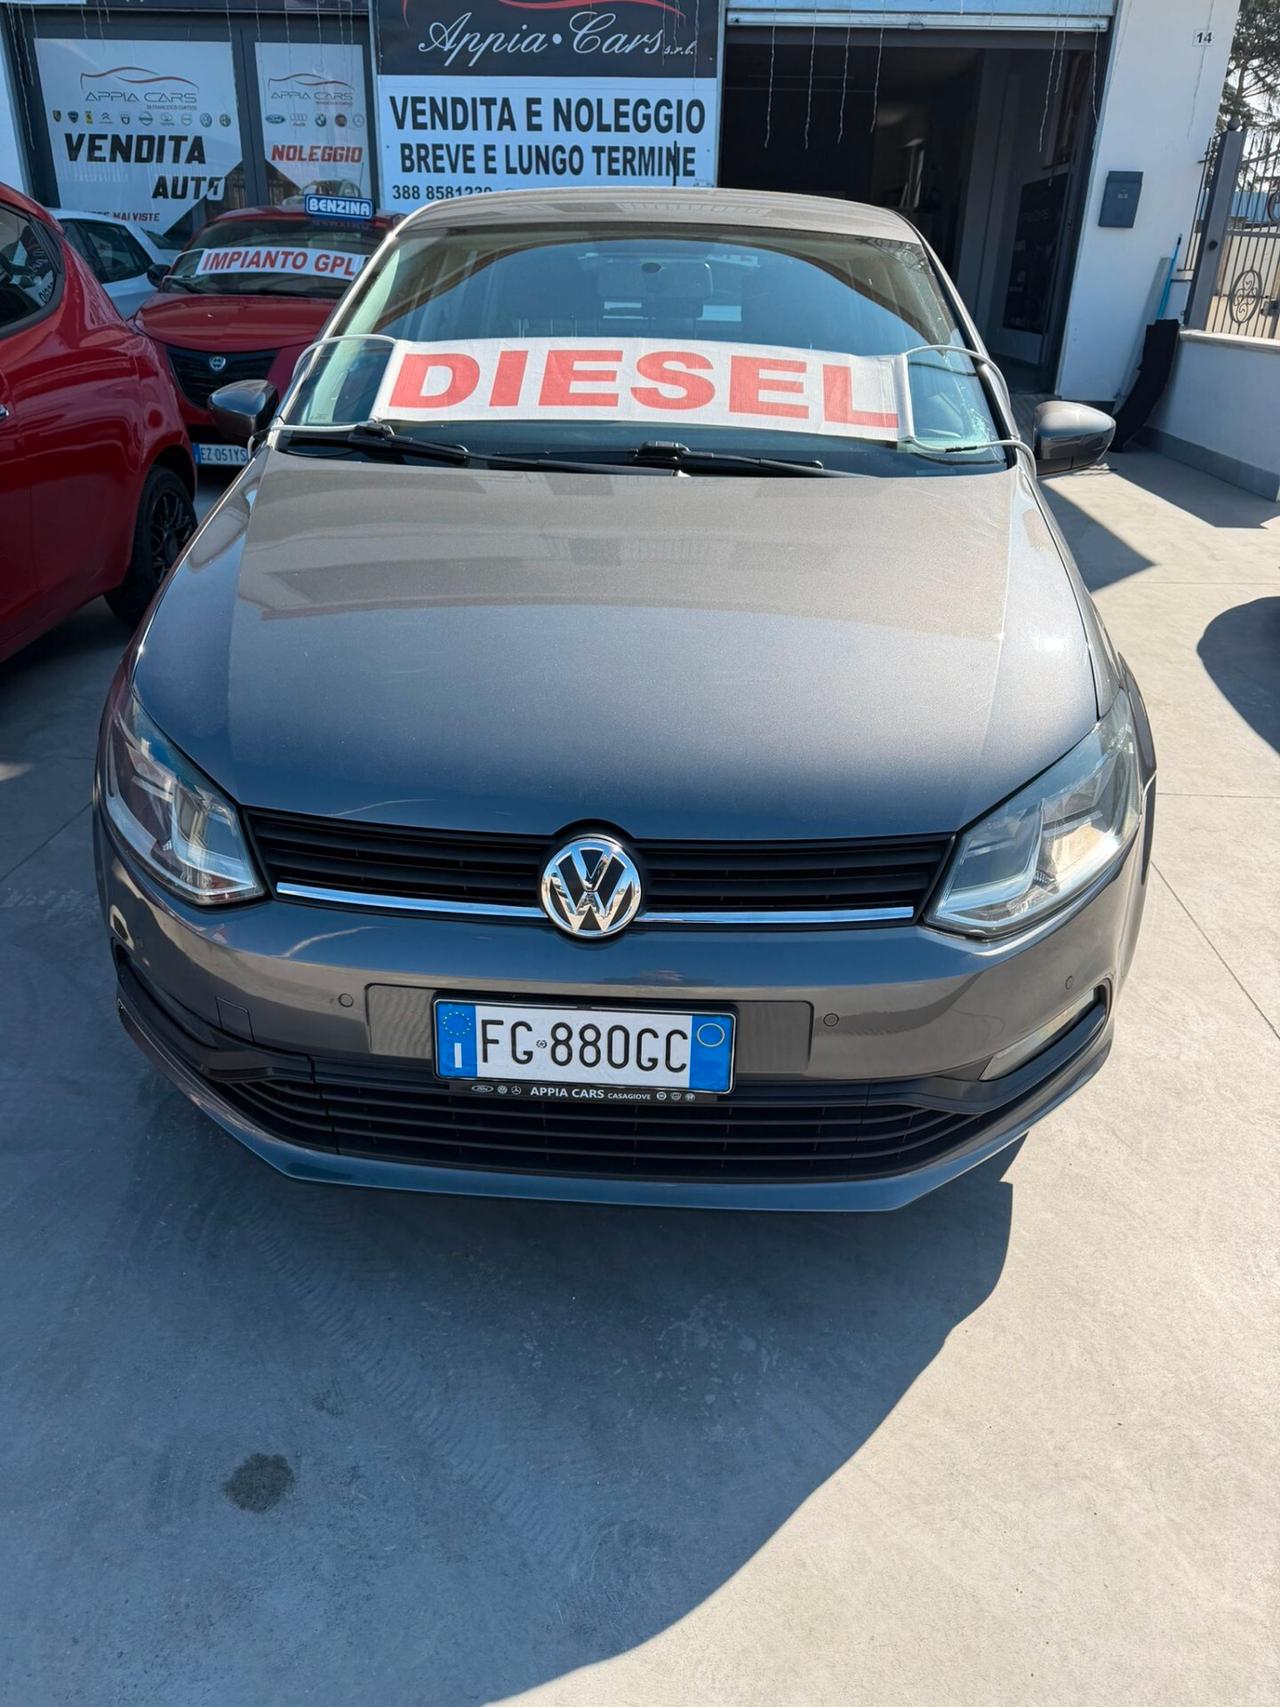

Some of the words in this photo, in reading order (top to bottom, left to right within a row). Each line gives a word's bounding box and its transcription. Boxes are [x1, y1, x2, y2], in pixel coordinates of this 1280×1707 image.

[418, 12, 549, 66] Appia
[569, 11, 664, 54] Cars
[1197, 31, 1212, 43] 14
[85, 91, 140, 102] APPIA
[144, 92, 197, 103] CARS
[389, 96, 516, 131] VENDITA
[527, 98, 542, 132] E
[553, 98, 705, 133] NOLEGGIO
[64, 133, 206, 164] VENDITA
[272, 145, 362, 163] NOLEGGIO
[401, 143, 476, 174] BREVE
[484, 144, 497, 174] E
[505, 145, 584, 175] LUNGO
[592, 146, 696, 177] TERMINE
[152, 176, 225, 200] AUTO
[392, 185, 421, 200] 388
[132, 212, 160, 221] VISTE
[309, 198, 370, 216] BENZINA
[202, 251, 308, 271] IMPIANTO
[314, 254, 355, 276] GPL
[388, 349, 898, 428] DIESEL
[481, 1019, 533, 1064] FG
[550, 1022, 688, 1073] 880GC
[530, 1086, 568, 1098] APPIA
[571, 1088, 605, 1099] CARS
[607, 1091, 651, 1100] CASAGIOVE
